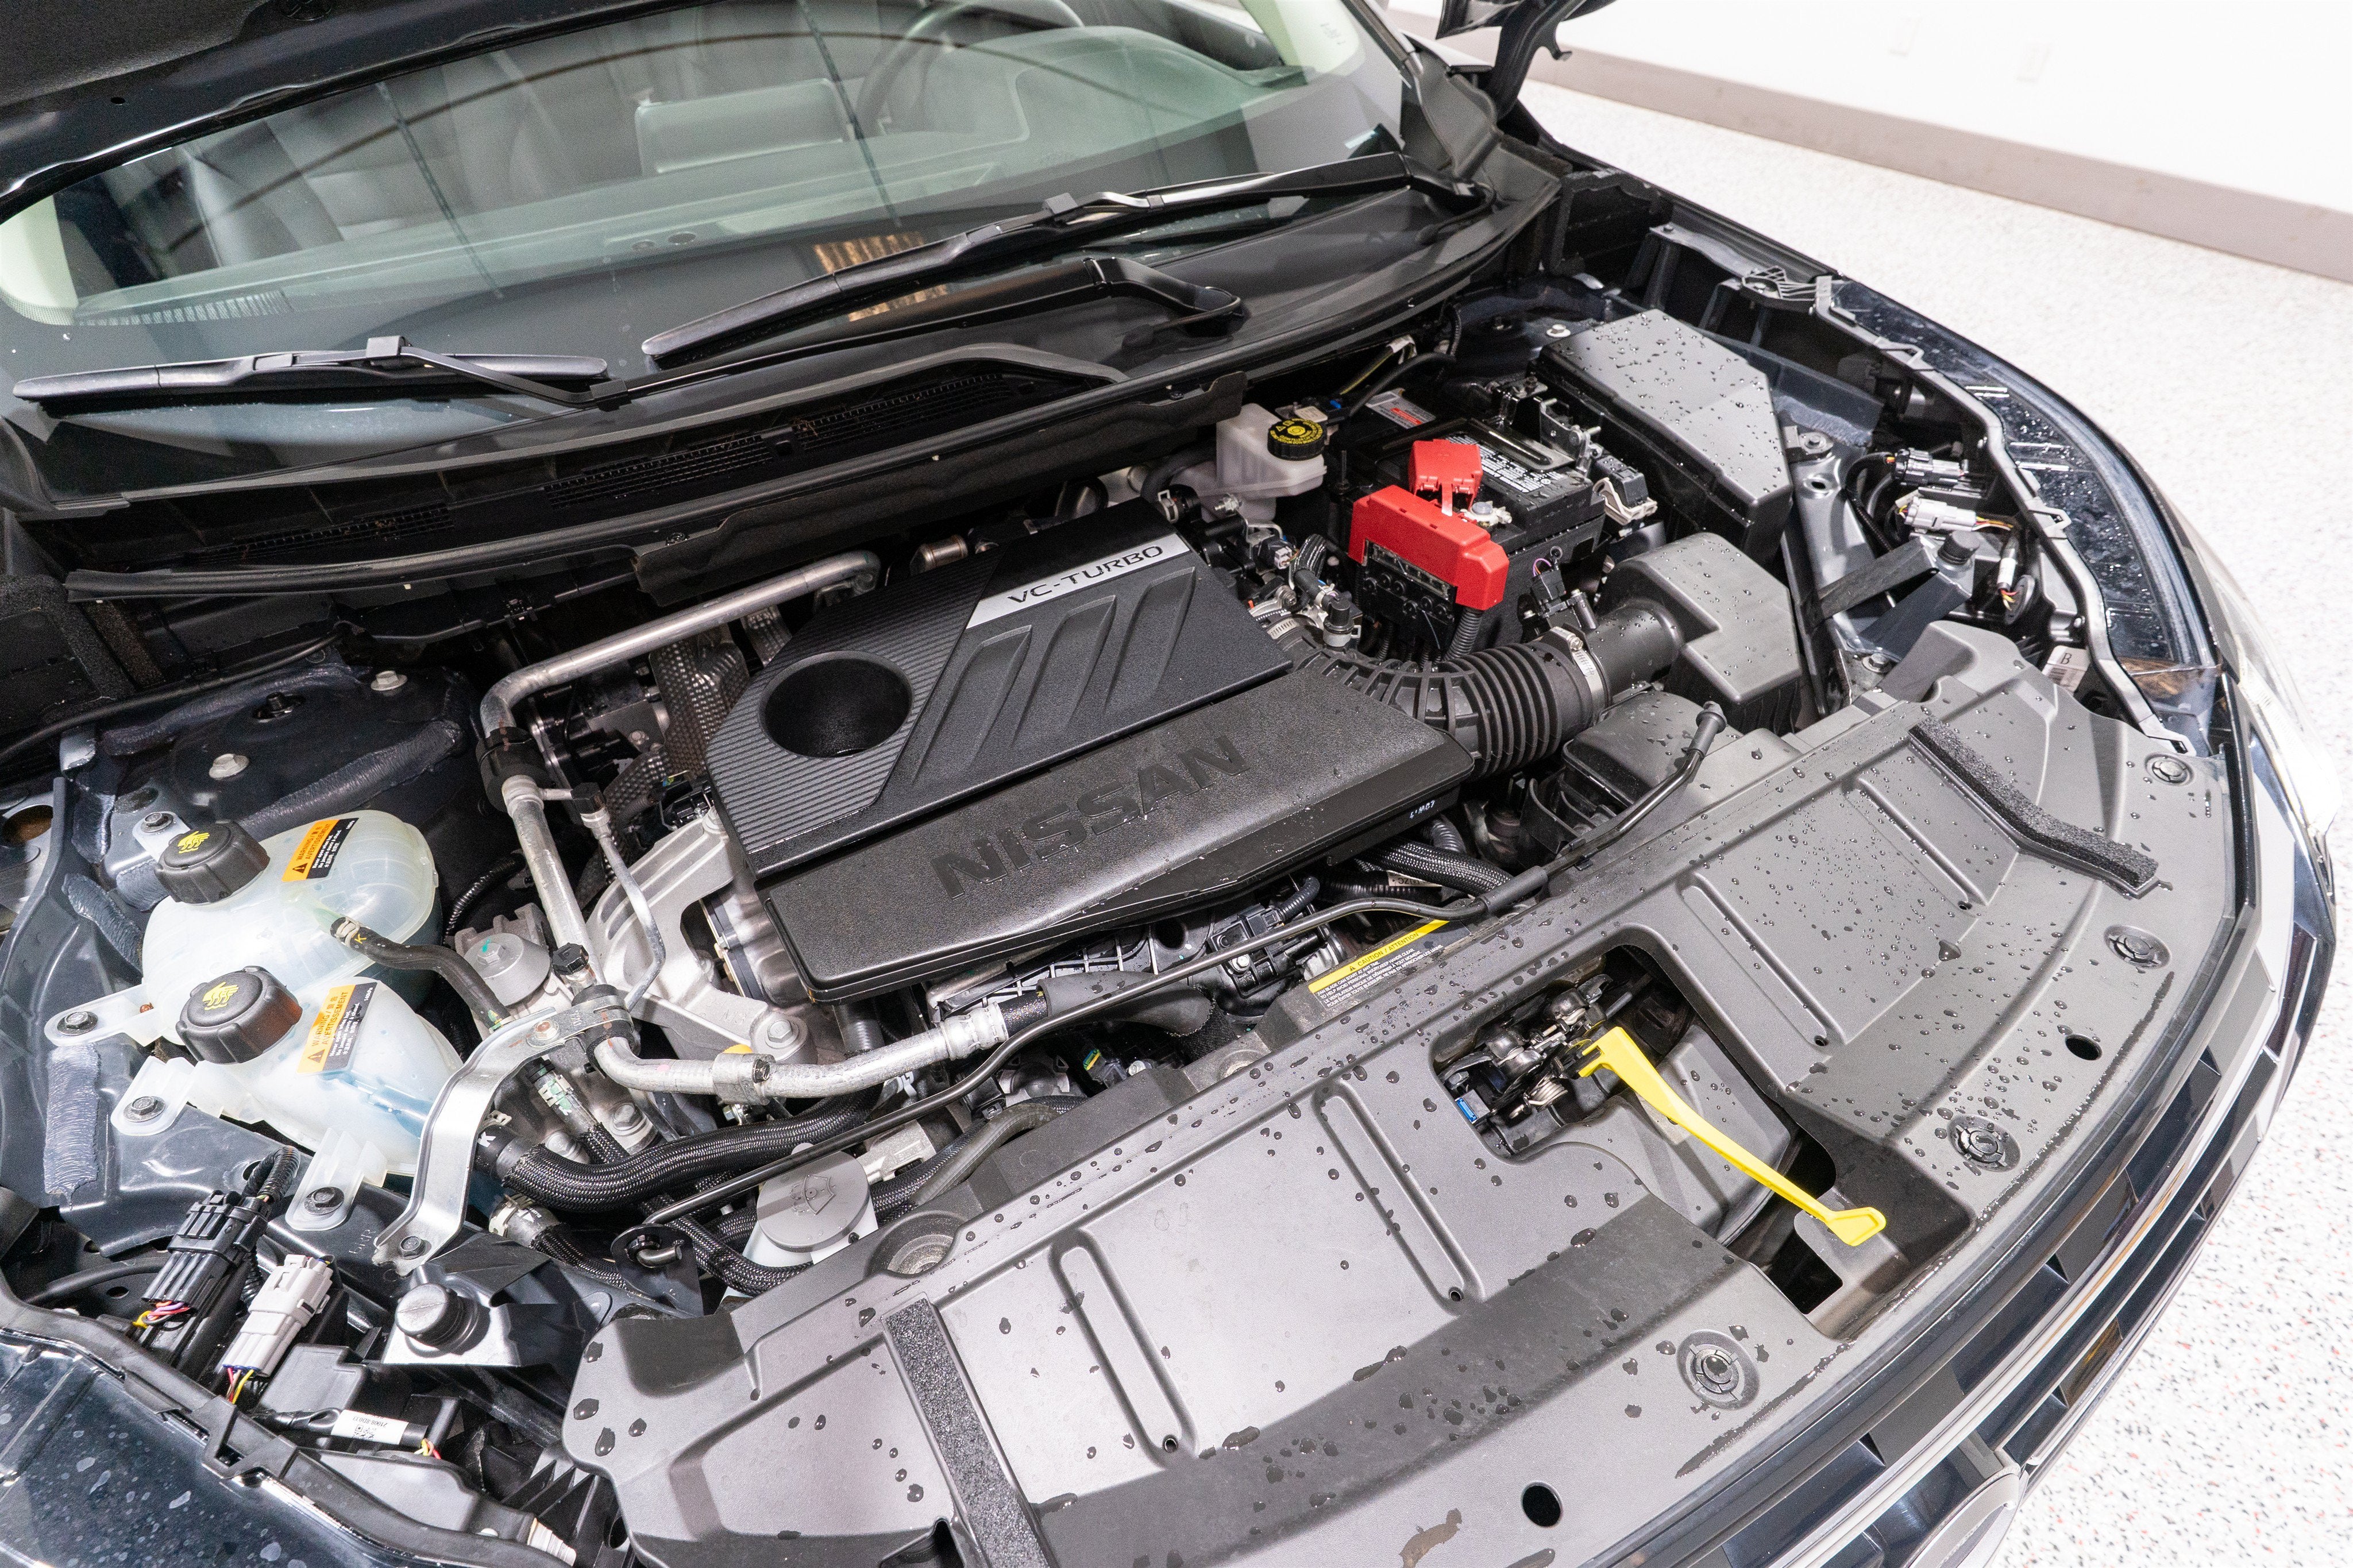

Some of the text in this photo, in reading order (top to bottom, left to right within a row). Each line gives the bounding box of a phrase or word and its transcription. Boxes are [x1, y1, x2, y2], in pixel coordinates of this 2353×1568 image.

[1008, 545, 1163, 604] VC-TURBO
[2061, 652, 2072, 665] B
[934, 735, 1252, 900] NISSAN
[306, 824, 331, 859] AVERTISSEMENT
[354, 934, 367, 944] K
[1357, 952, 1384, 967] CAUTION
[1388, 932, 1419, 951] ATTENTION
[1325, 983, 1338, 992] BLADE
[1347, 972, 1358, 980] START
[1327, 999, 1339, 1007] POUR
[1337, 992, 1352, 1002] ÉVITER
[1351, 987, 1363, 995] TOUTE
[1402, 955, 1424, 968] APPROCHER
[1430, 944, 1444, 953] MAINS.
[1329, 987, 1353, 1001] VENTILATEUR
[1353, 979, 1367, 988] RISQUE
[1372, 965, 1392, 978] DÉMARRER
[1405, 950, 1422, 961] MOMENT.
[1336, 983, 1348, 991] AVOID
[1348, 973, 1368, 986] PERSONAL
[1389, 955, 1402, 963] HANDS
[1402, 948, 1415, 957] CLEAR.
[312, 1015, 329, 1046] WARNING
[322, 991, 348, 1045] AVERTISSEMENT
[329, 1043, 338, 1056] Never
[339, 1019, 347, 1029] when
[477, 1131, 496, 1148] K
